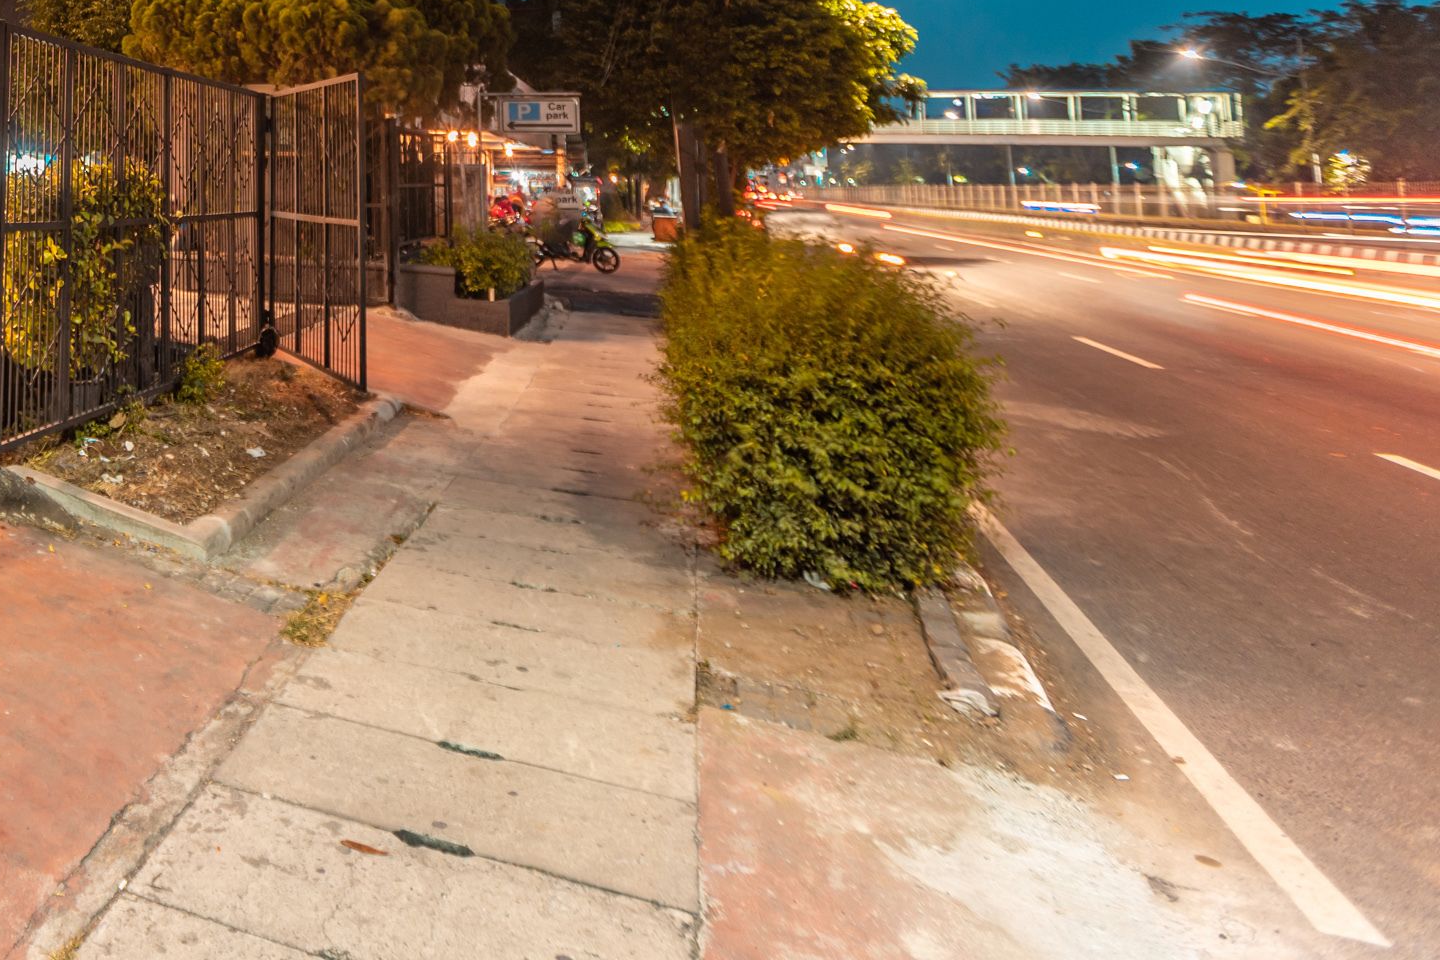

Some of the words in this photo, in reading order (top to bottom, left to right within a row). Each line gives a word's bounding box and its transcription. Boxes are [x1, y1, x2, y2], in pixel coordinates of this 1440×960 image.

[518, 104, 531, 119] P
[548, 103, 566, 111] Car
[546, 111, 569, 121] park
